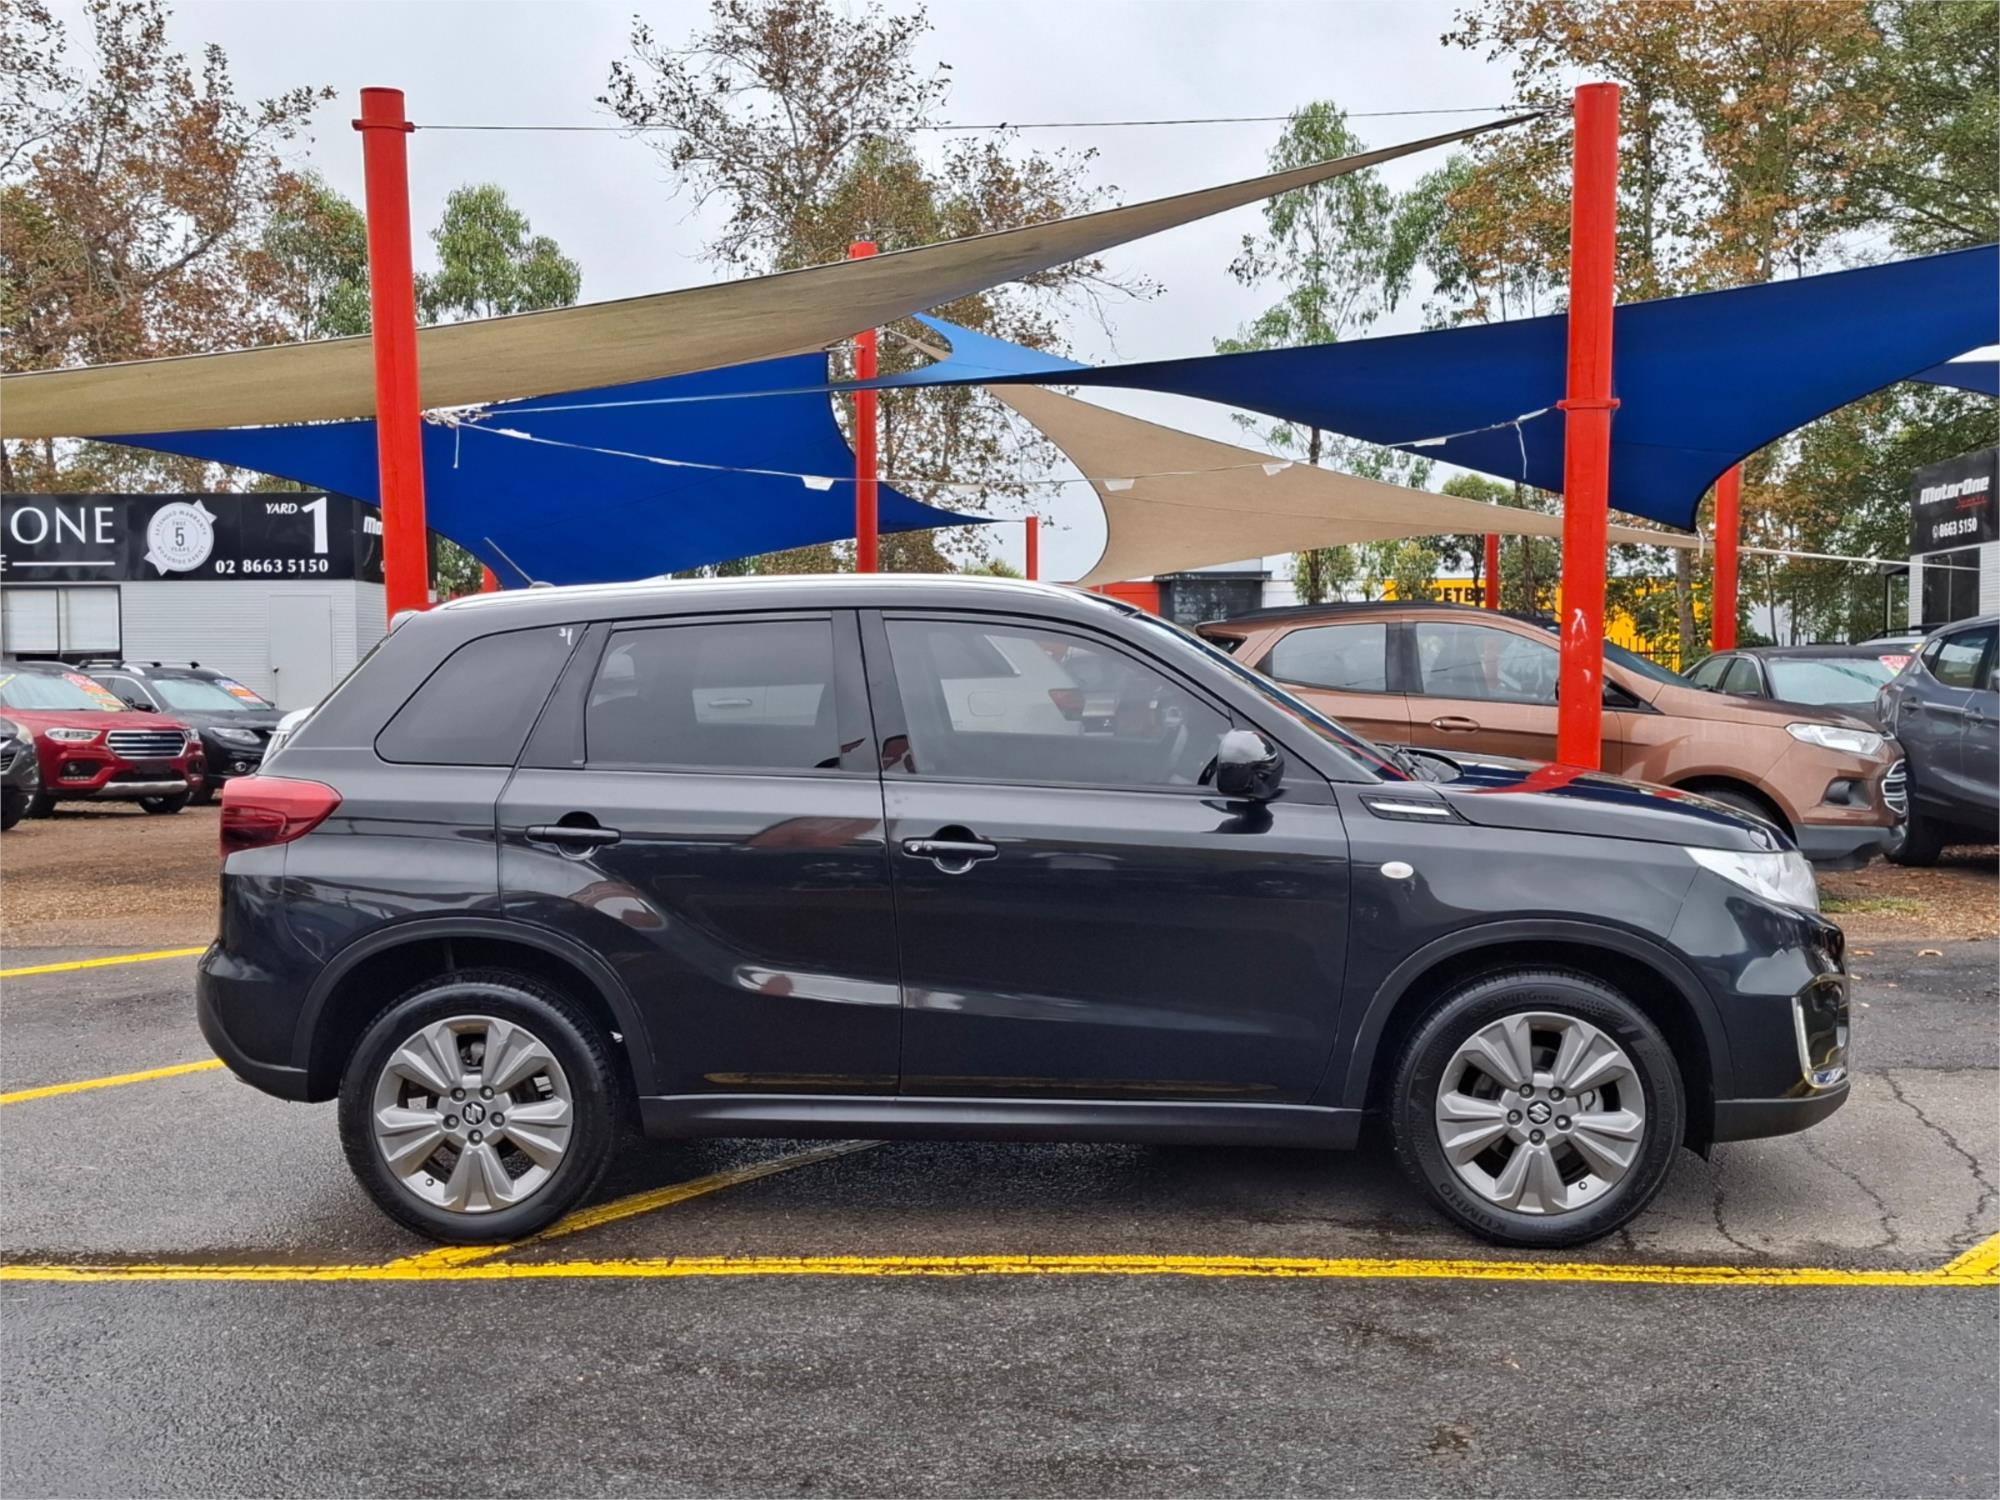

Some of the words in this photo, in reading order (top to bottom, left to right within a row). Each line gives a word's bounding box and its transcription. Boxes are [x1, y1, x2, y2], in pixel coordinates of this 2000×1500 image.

[10, 506, 115, 544] ONE
[175, 527, 185, 547] 5
[265, 502, 299, 515] YARD
[301, 496, 328, 554] 1
[215, 560, 236, 574] 02
[242, 559, 283, 573] 8663
[287, 559, 329, 573] 5150
